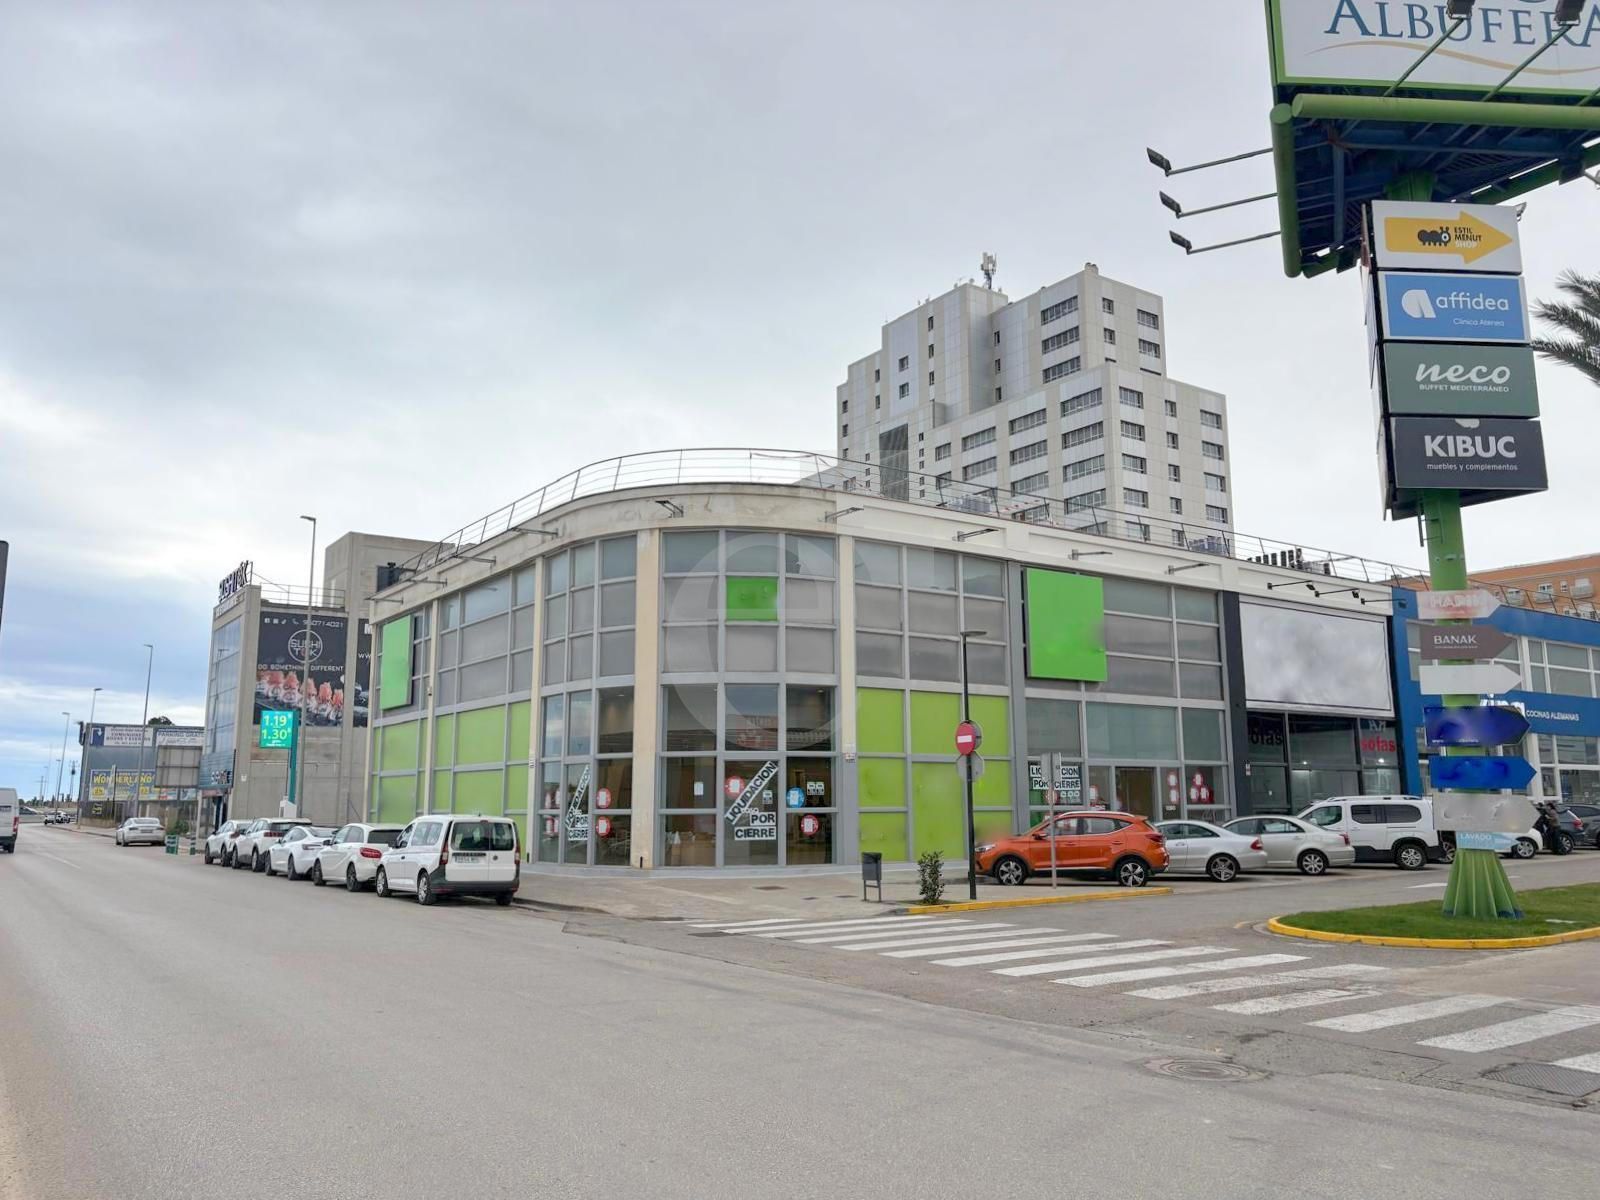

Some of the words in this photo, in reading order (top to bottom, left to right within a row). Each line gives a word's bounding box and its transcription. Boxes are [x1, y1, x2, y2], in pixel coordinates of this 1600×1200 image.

[1454, 226, 1473, 234] ESTIL
[1454, 233, 1482, 242] MENUT
[1436, 292, 1509, 311] affidea
[1415, 363, 1511, 384] neco
[1424, 435, 1517, 458] KIBUC
[1465, 463, 1518, 471] complementos
[290, 639, 321, 650] SUHI
[1433, 635, 1478, 645] BANAK
[263, 715, 288, 727] 1.19
[1526, 710, 1550, 719] COCINAS
[1550, 712, 1580, 721] ALEMANAS
[261, 728, 288, 740] 1.30
[1361, 735, 1396, 753] sofas
[725, 762, 777, 823] LIQUIDACION
[751, 814, 775, 824] POR
[735, 827, 776, 839] CIERRE
[1460, 832, 1492, 840] LAVADO
